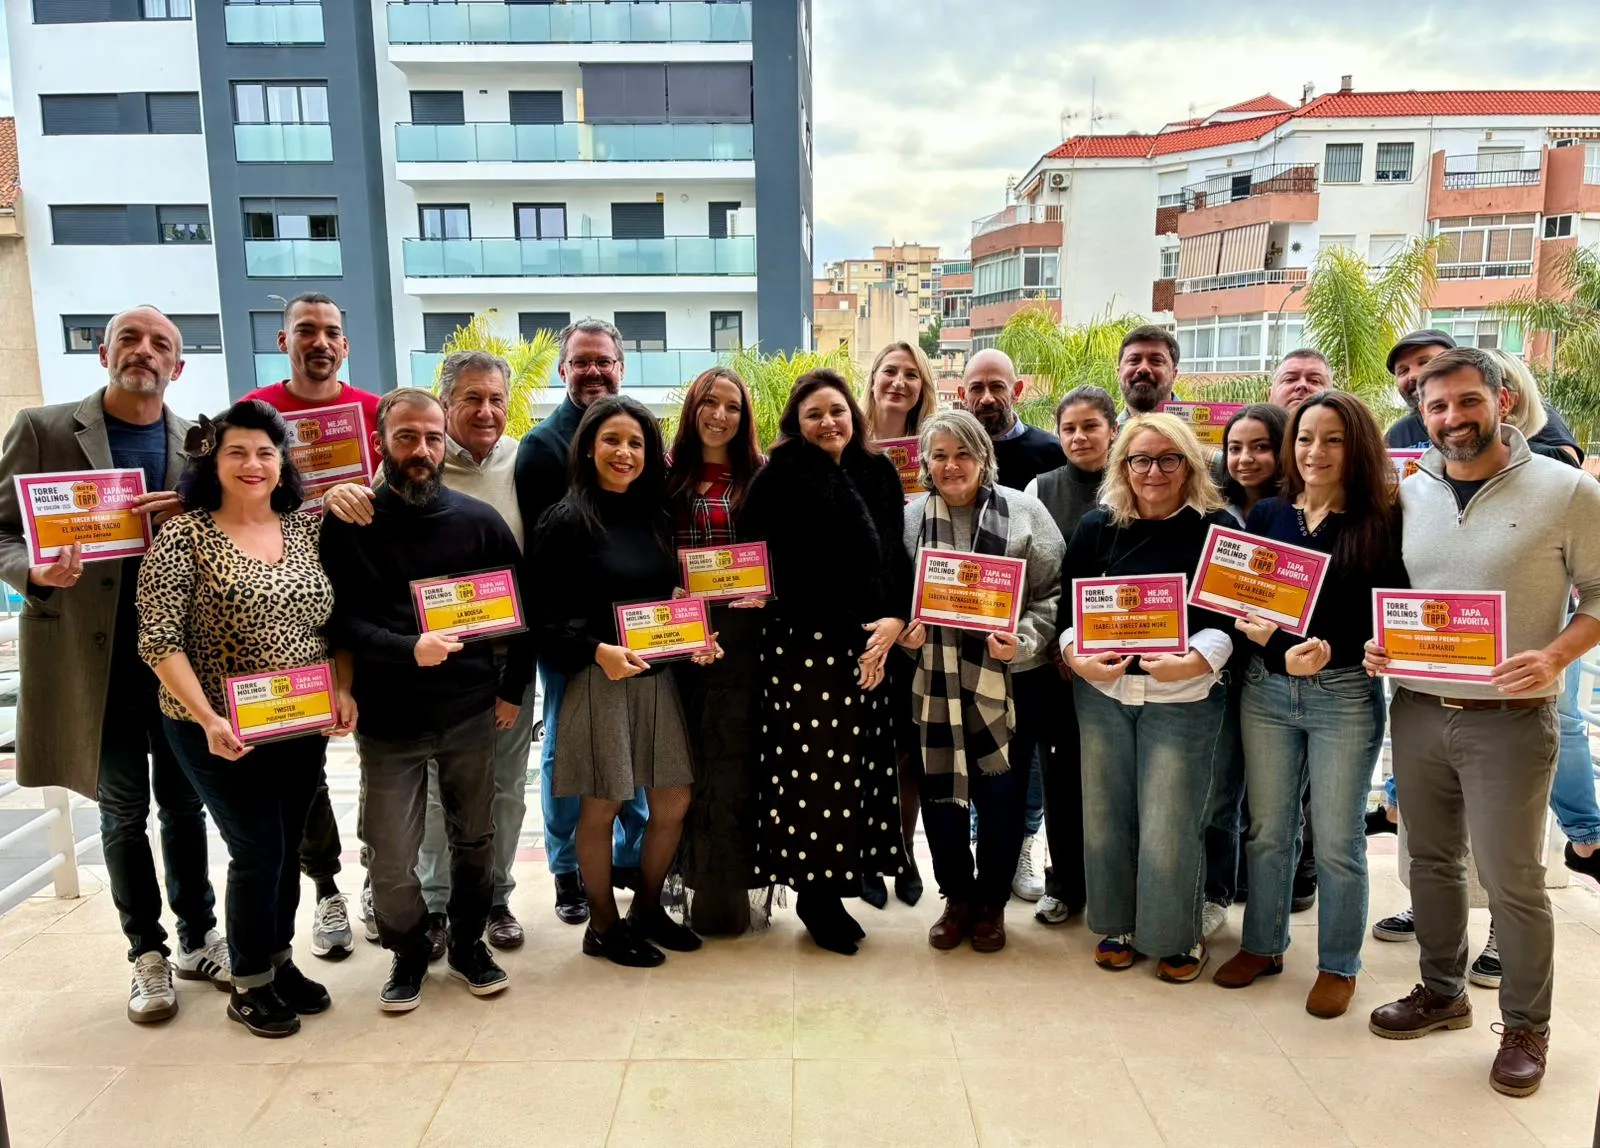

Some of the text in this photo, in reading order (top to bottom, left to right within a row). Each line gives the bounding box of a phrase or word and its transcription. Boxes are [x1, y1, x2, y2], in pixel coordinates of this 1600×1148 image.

[325, 426, 352, 436] SERVICIO
[33, 487, 58, 495] TORRE
[35, 494, 69, 503] MOLINOS
[78, 495, 96, 505] TAPA
[103, 494, 134, 503] CREATIVA
[1220, 540, 1240, 550] TORRE
[1217, 547, 1247, 560] MOLINOS
[1258, 550, 1274, 558] RUTA
[1253, 558, 1272, 571] TAPA
[1287, 561, 1304, 572] TAPA
[962, 571, 977, 579] TAPA
[1277, 567, 1309, 582] FAVORITA
[983, 577, 1011, 586] CREATIVA
[1238, 575, 1276, 590] TERCER PREMIO
[480, 586, 506, 594] CREATIVA
[1234, 582, 1252, 593] OVEJA
[1252, 587, 1276, 599] REBELDE
[425, 592, 452, 600] MOLINOS
[1120, 597, 1137, 606] TAPA
[1460, 608, 1481, 617] TAPA
[1426, 614, 1446, 624] TAPA
[1453, 617, 1489, 626] FAVORITA
[1427, 644, 1455, 652] ARMARIO
[274, 685, 289, 693] TAPA
[296, 681, 323, 689] CREATIVA
[237, 687, 266, 696] MOLINOS
[274, 705, 296, 714] TWISTER
